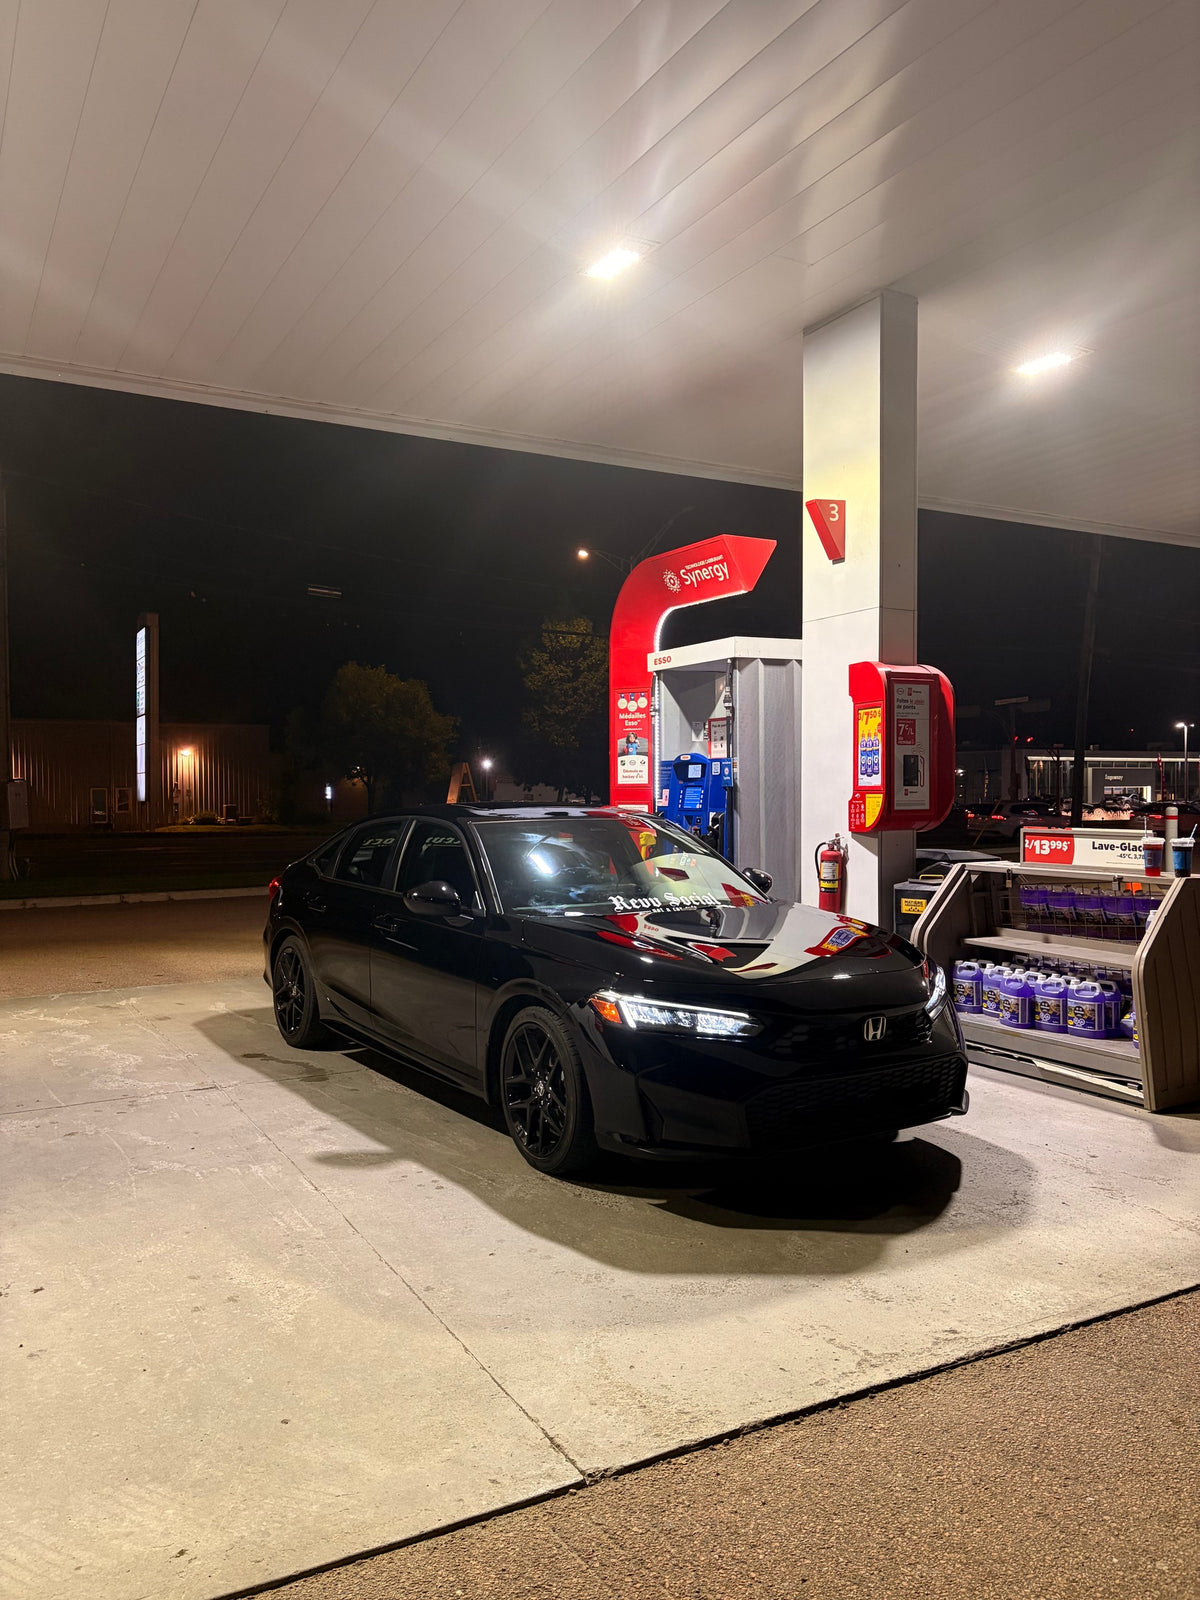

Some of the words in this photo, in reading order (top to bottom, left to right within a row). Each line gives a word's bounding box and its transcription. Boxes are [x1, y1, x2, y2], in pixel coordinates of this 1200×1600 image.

[829, 503, 839, 522] 3
[680, 562, 729, 588] Synergy
[653, 655, 672, 666] ESSO
[618, 712, 646, 720] Médailles
[1092, 841, 1145, 852] Lave-Glac
[663, 892, 722, 907] Social
